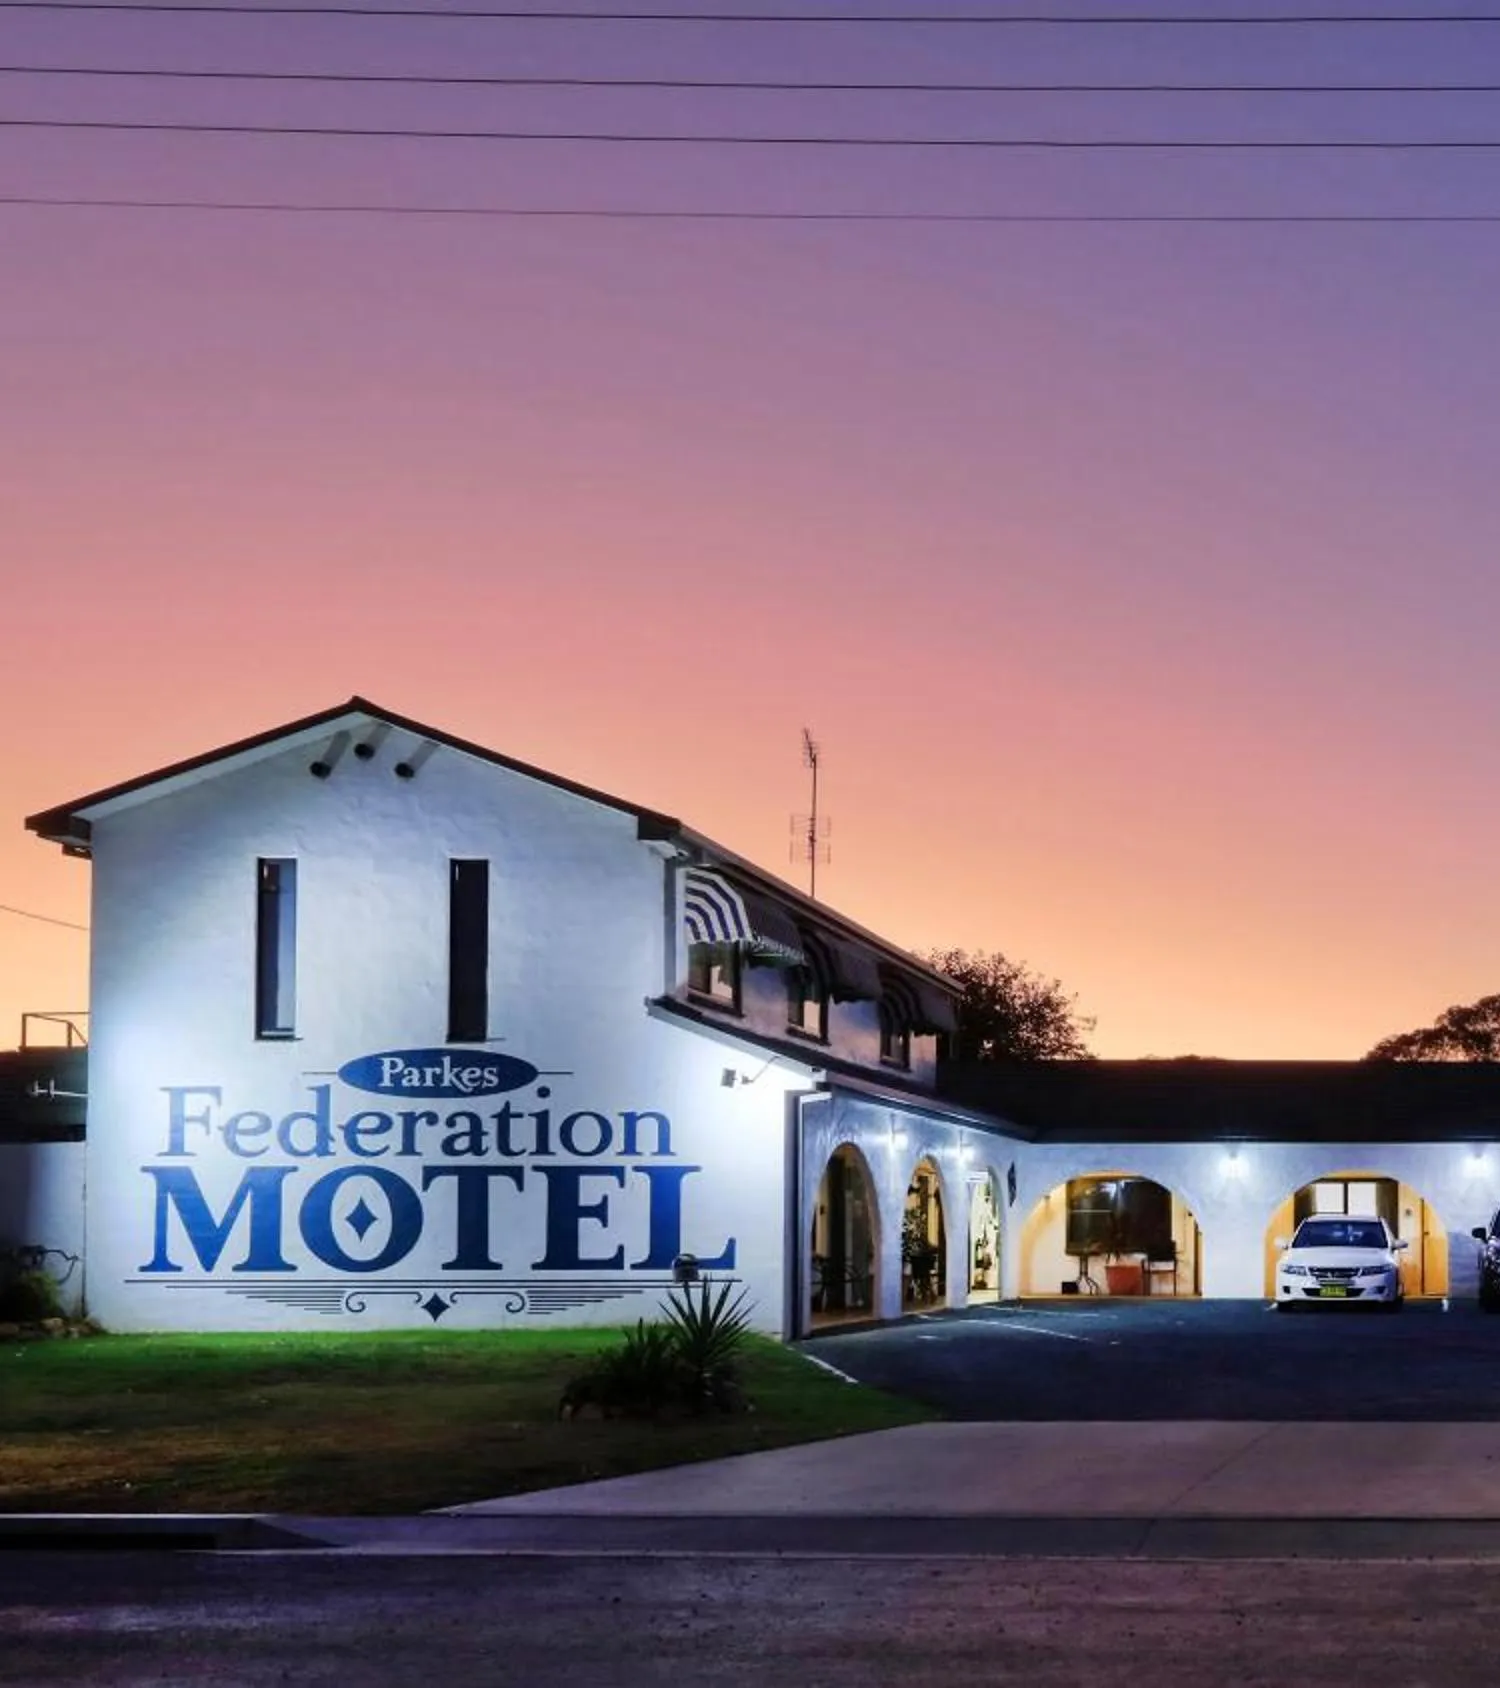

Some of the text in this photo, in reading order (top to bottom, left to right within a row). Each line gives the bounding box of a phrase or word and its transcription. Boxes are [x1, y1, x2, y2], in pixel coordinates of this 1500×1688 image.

[379, 1056, 500, 1093] Parkes
[156, 1084, 678, 1158] Federation
[137, 1165, 737, 1273] MOTEL
